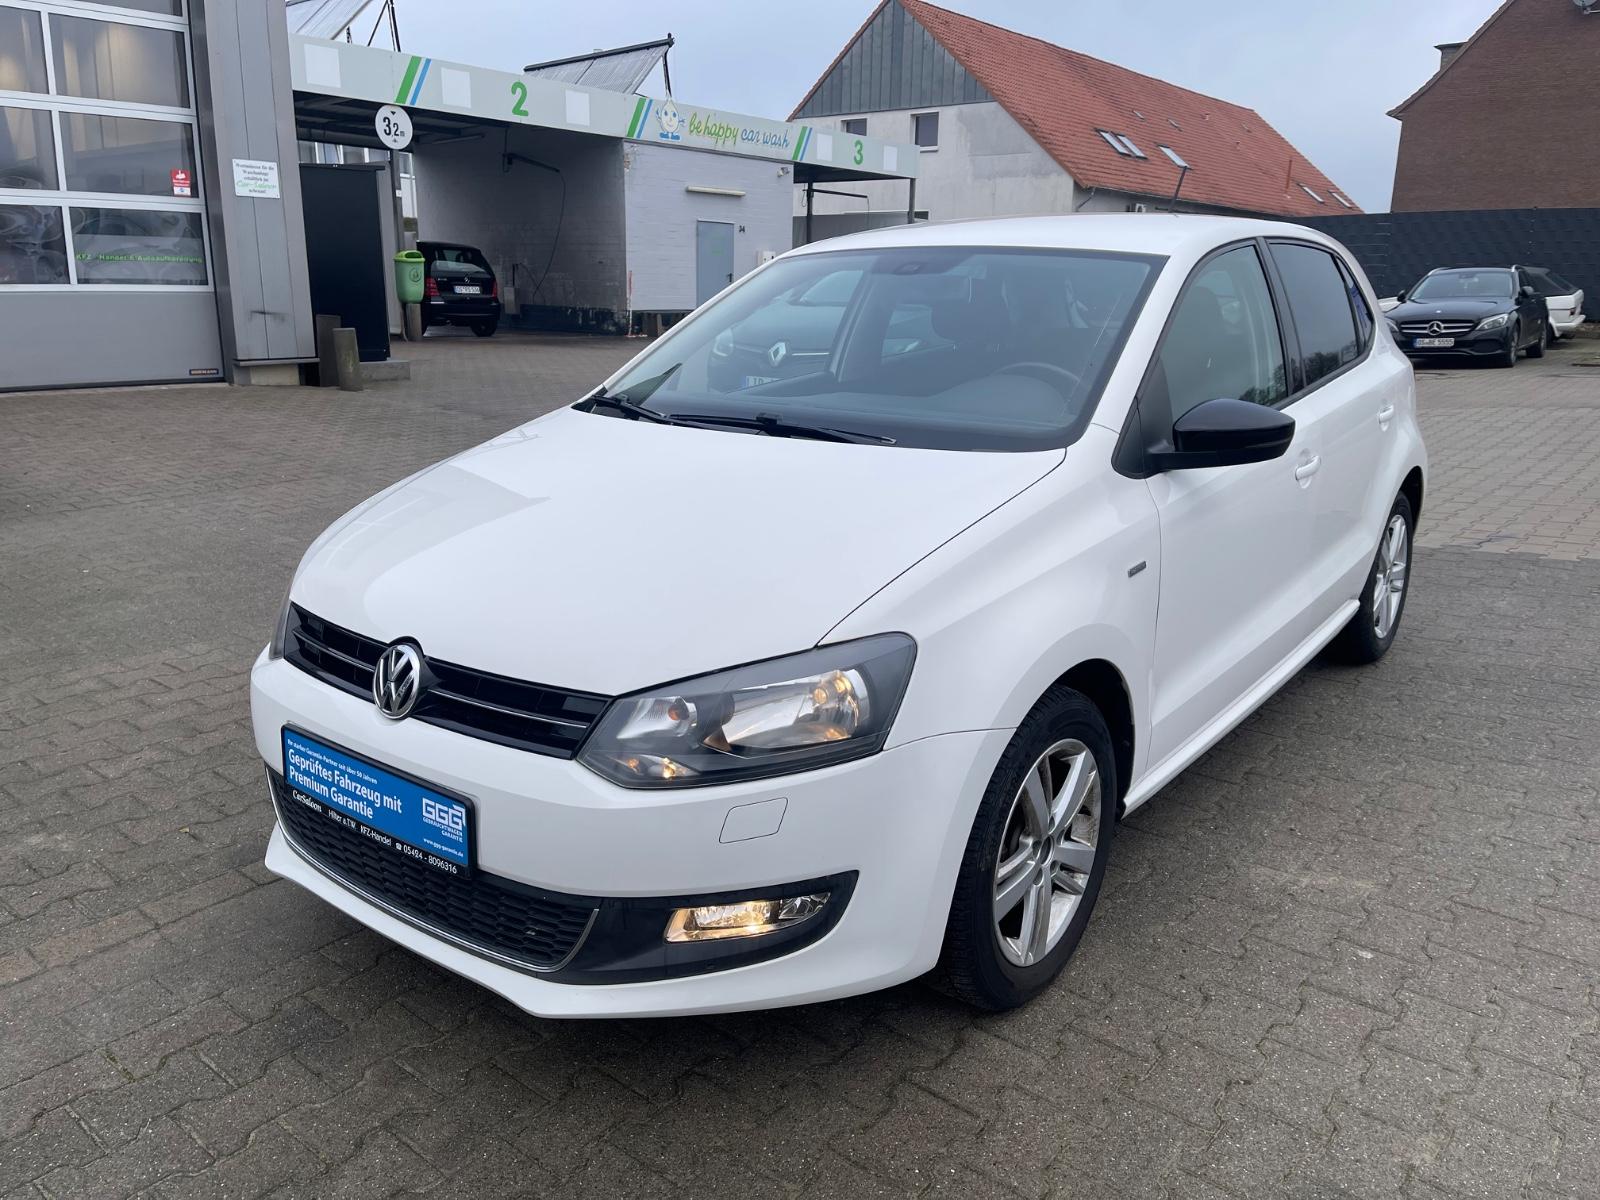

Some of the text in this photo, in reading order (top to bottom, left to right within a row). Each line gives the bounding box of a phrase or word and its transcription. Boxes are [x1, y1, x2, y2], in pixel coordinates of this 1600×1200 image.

[510, 81, 529, 117] 2
[688, 112, 791, 149] be happy car wash
[853, 139, 864, 166] 3
[374, 645, 420, 718] VW
[288, 748, 402, 814] Geprüftes Fahrzeug mit
[289, 765, 374, 820] Premium Garantie
[356, 770, 363, 778] 50
[292, 789, 322, 813] CarSaloon
[428, 854, 458, 874] 8096316
[422, 797, 464, 831] GGG
